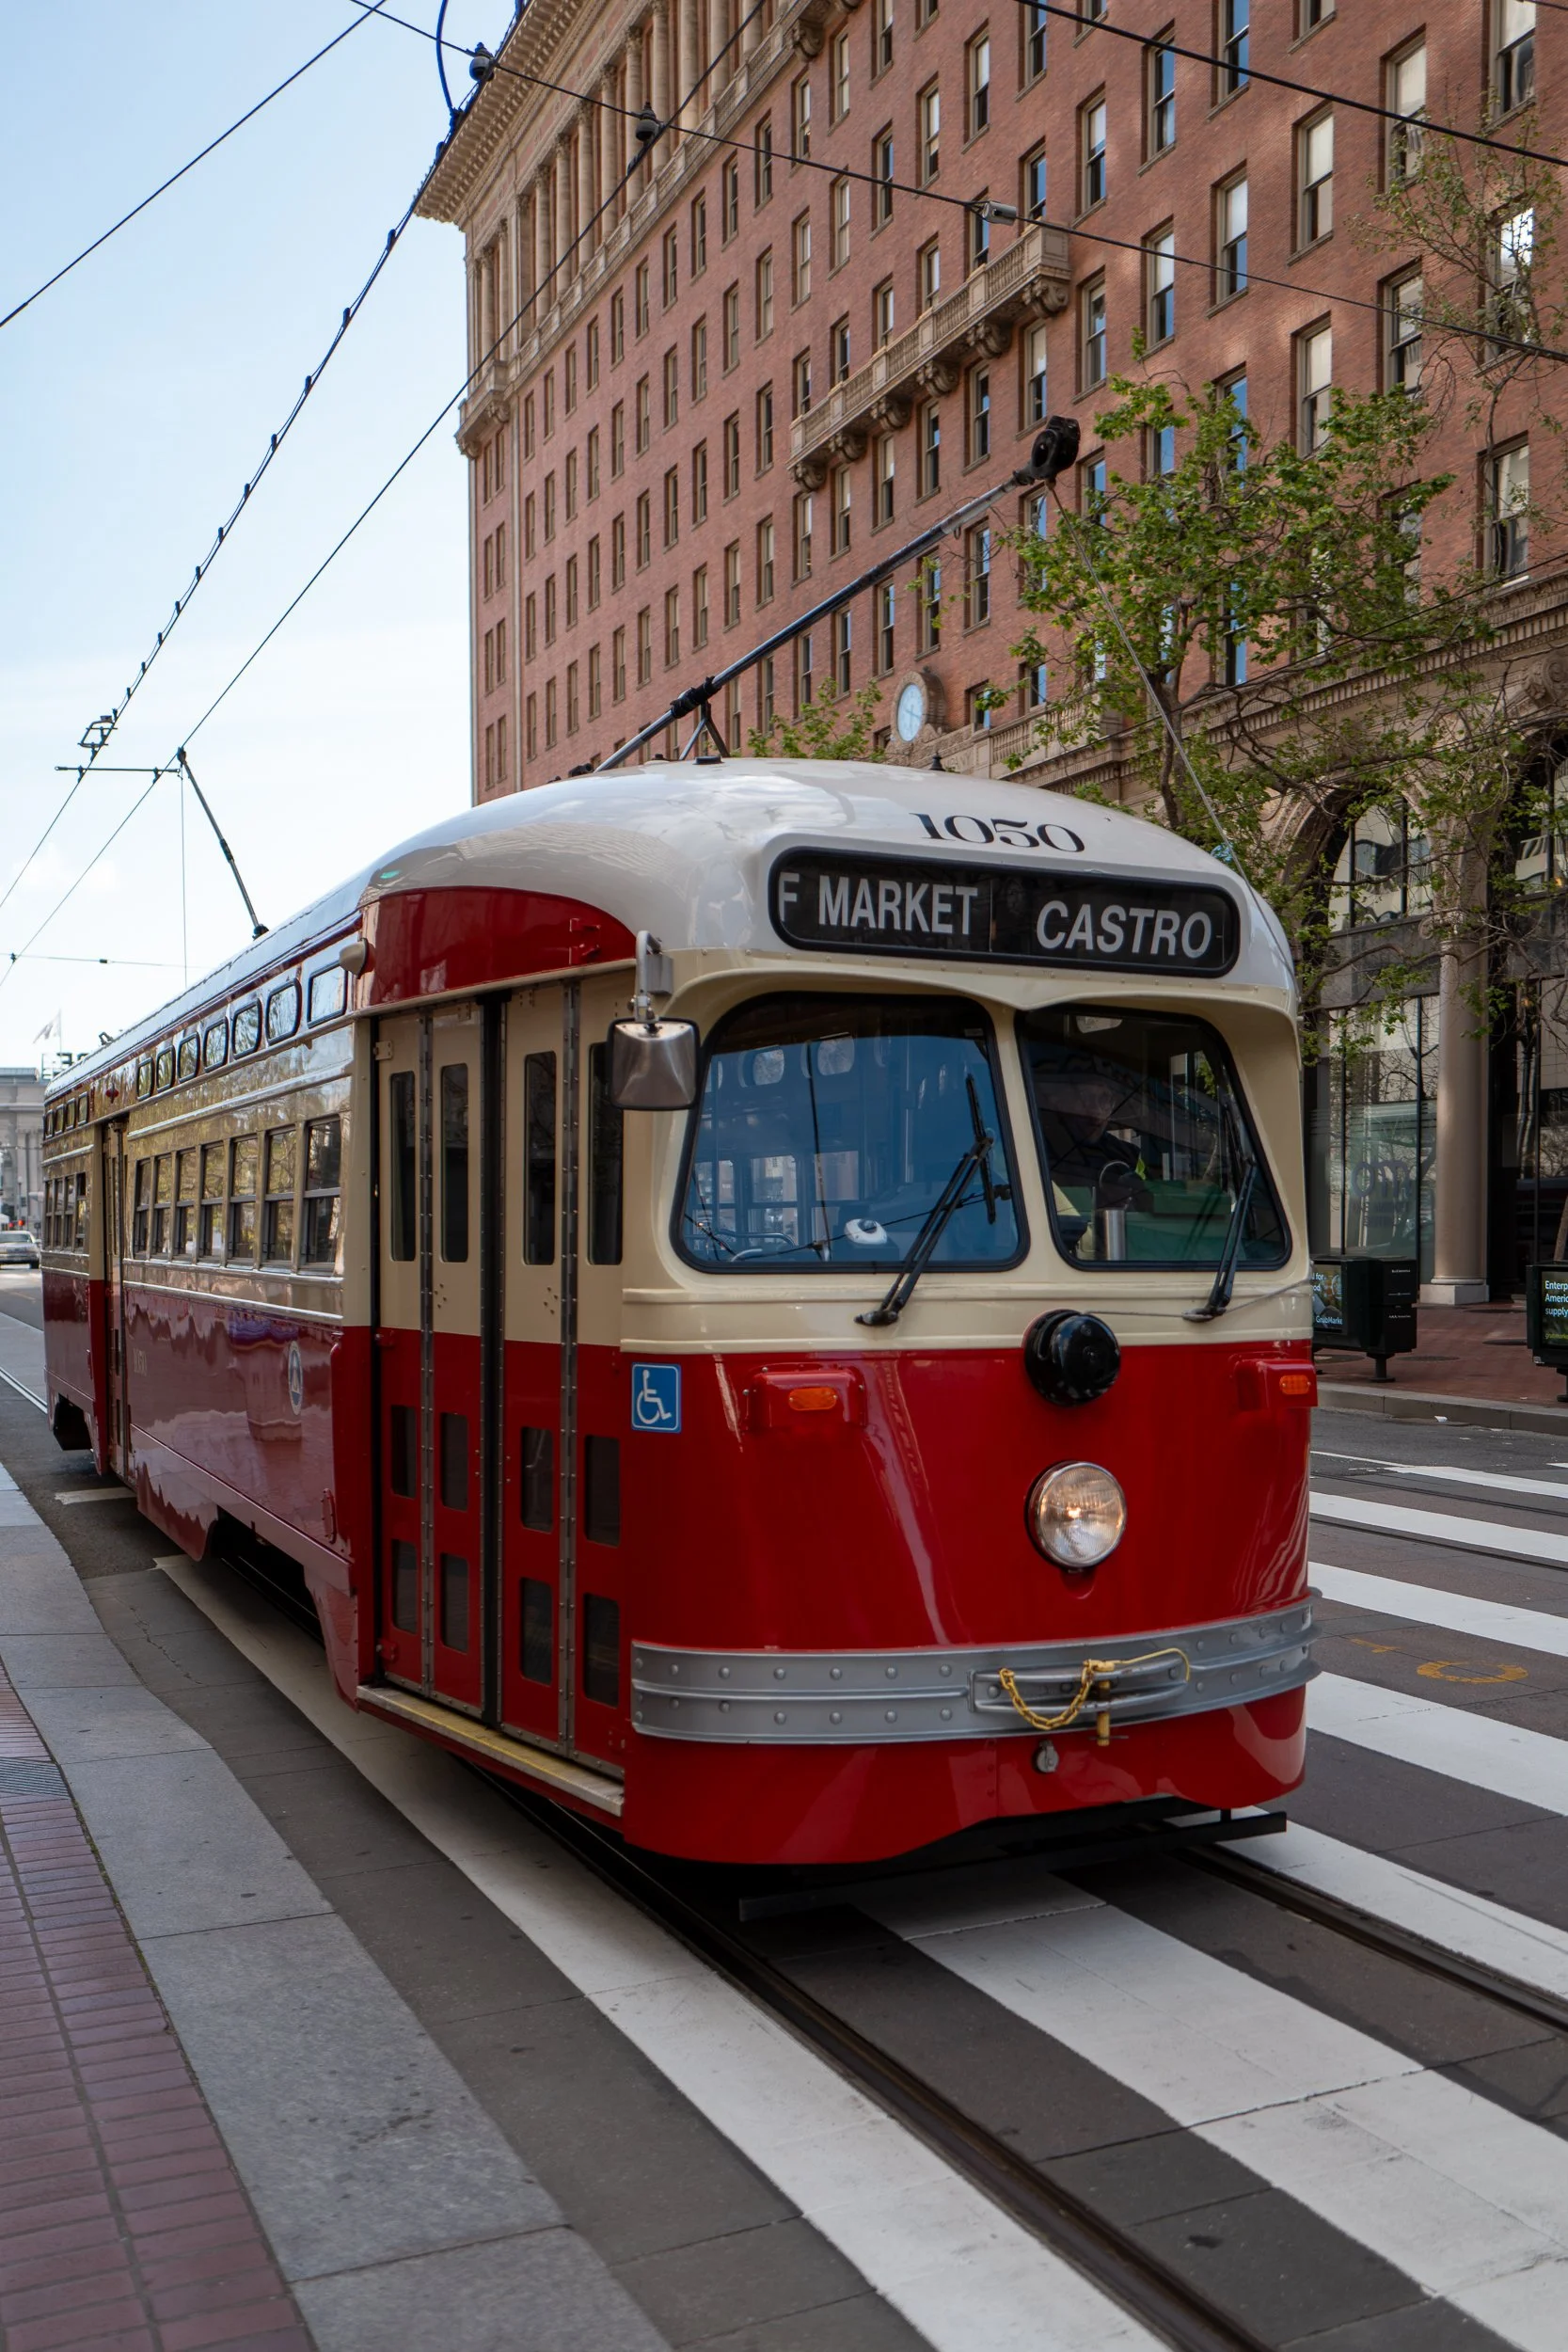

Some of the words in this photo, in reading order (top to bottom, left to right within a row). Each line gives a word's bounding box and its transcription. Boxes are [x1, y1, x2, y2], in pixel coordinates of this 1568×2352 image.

[910, 813, 1085, 852] 1050
[778, 871, 800, 922] F
[818, 874, 978, 935] MARKET
[1036, 899, 1212, 959] CASTRO
